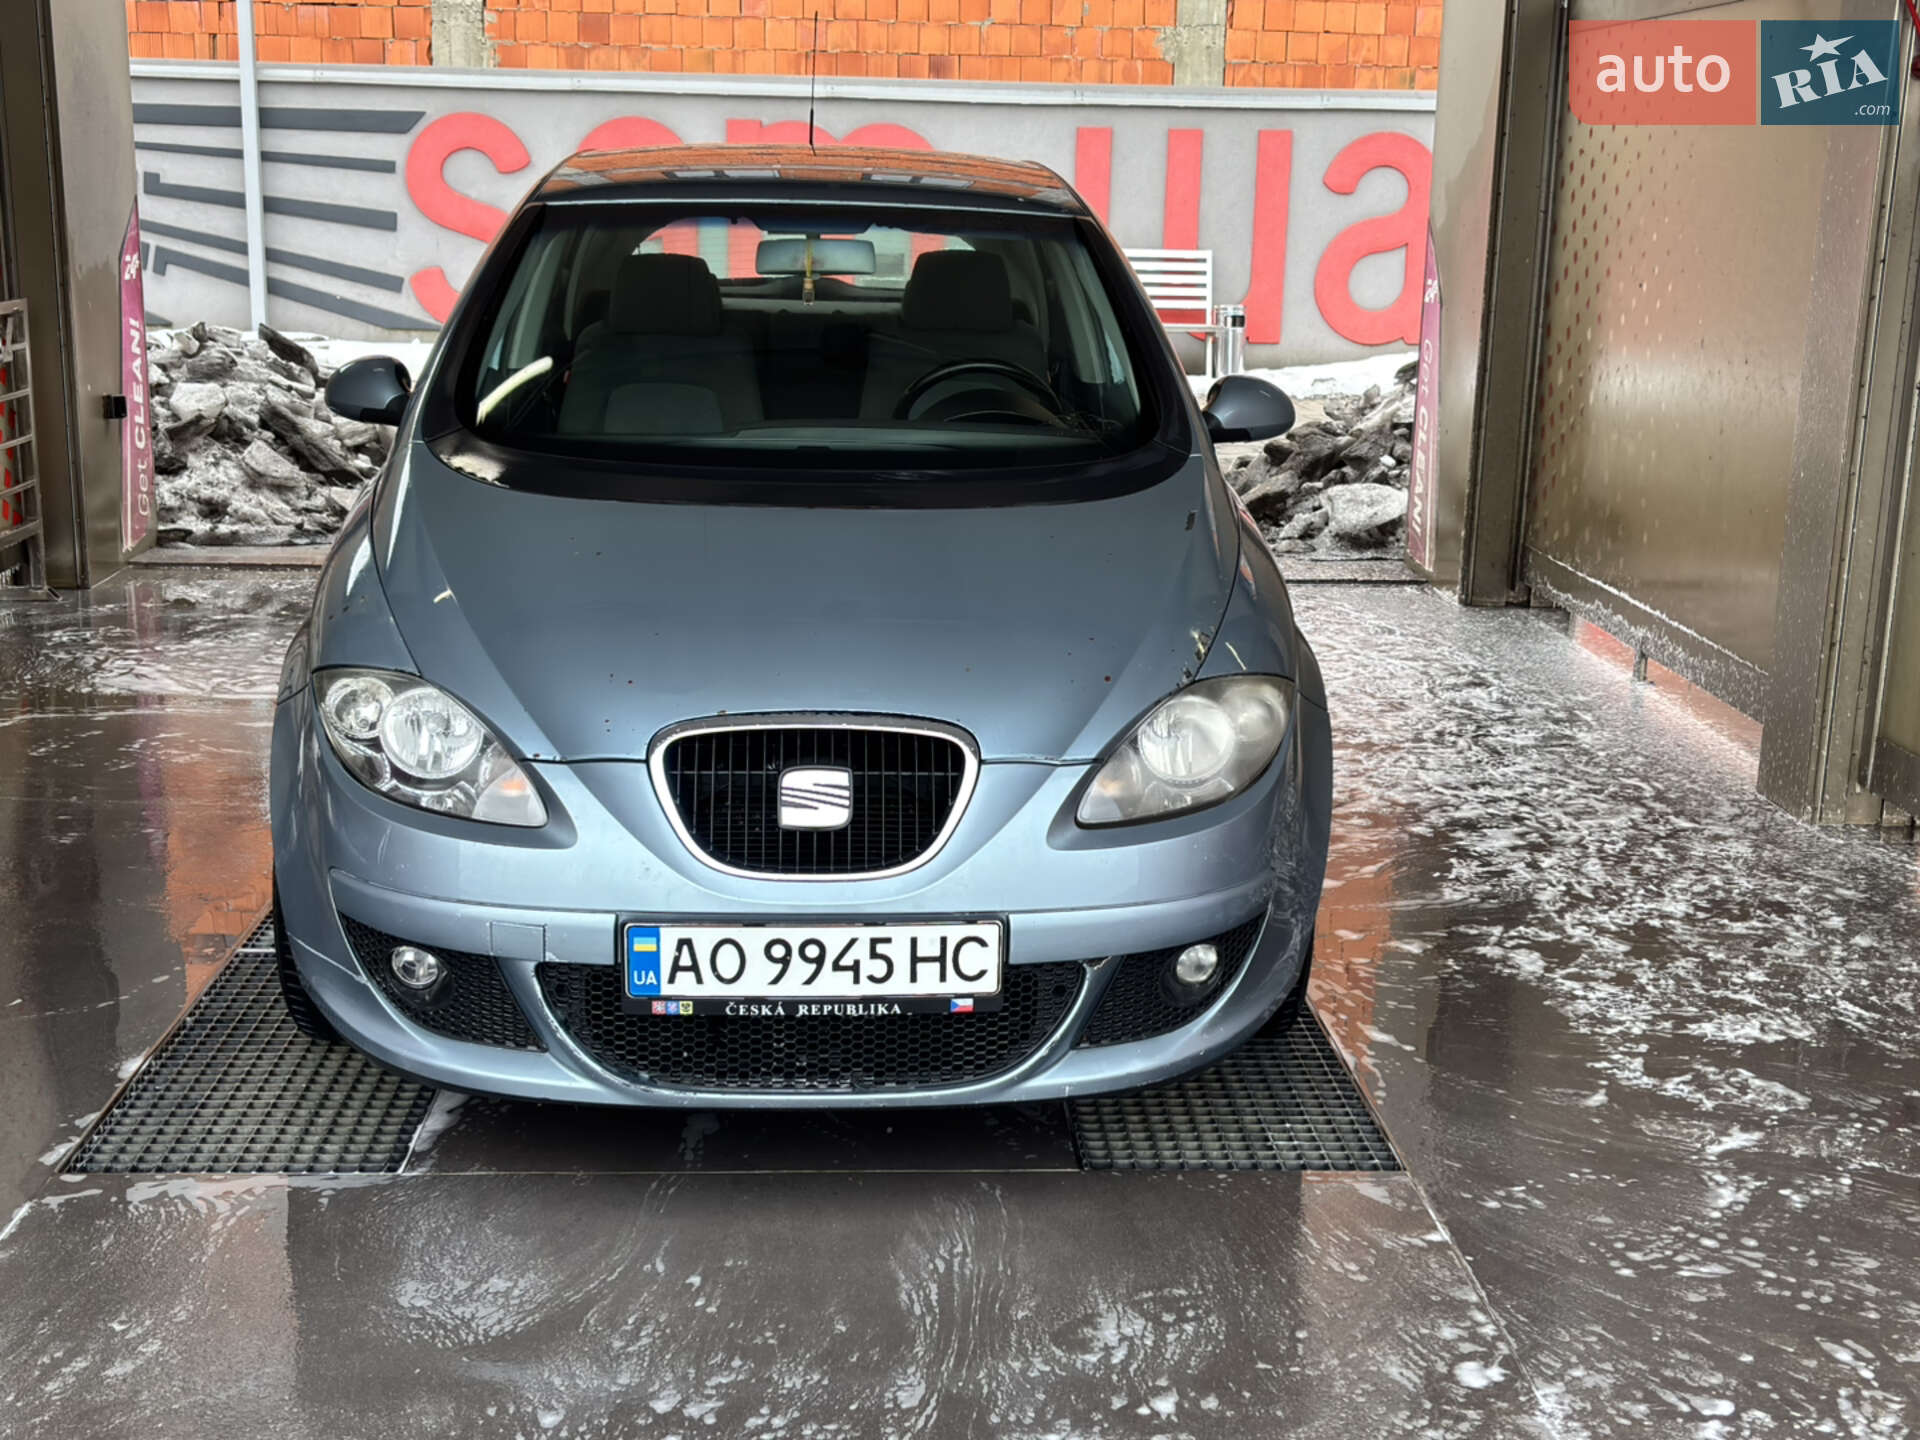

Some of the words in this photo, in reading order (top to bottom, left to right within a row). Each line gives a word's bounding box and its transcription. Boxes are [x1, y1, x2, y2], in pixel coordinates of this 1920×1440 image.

[128, 317, 147, 449] CLEAN!
[136, 458, 151, 517] Get
[633, 971, 658, 985] UA
[667, 937, 747, 985] AO
[763, 937, 895, 985] 9945
[908, 935, 990, 984] HC
[725, 1001, 786, 1016] ČESKÁ
[796, 1003, 902, 1017] REPUBLIKA
